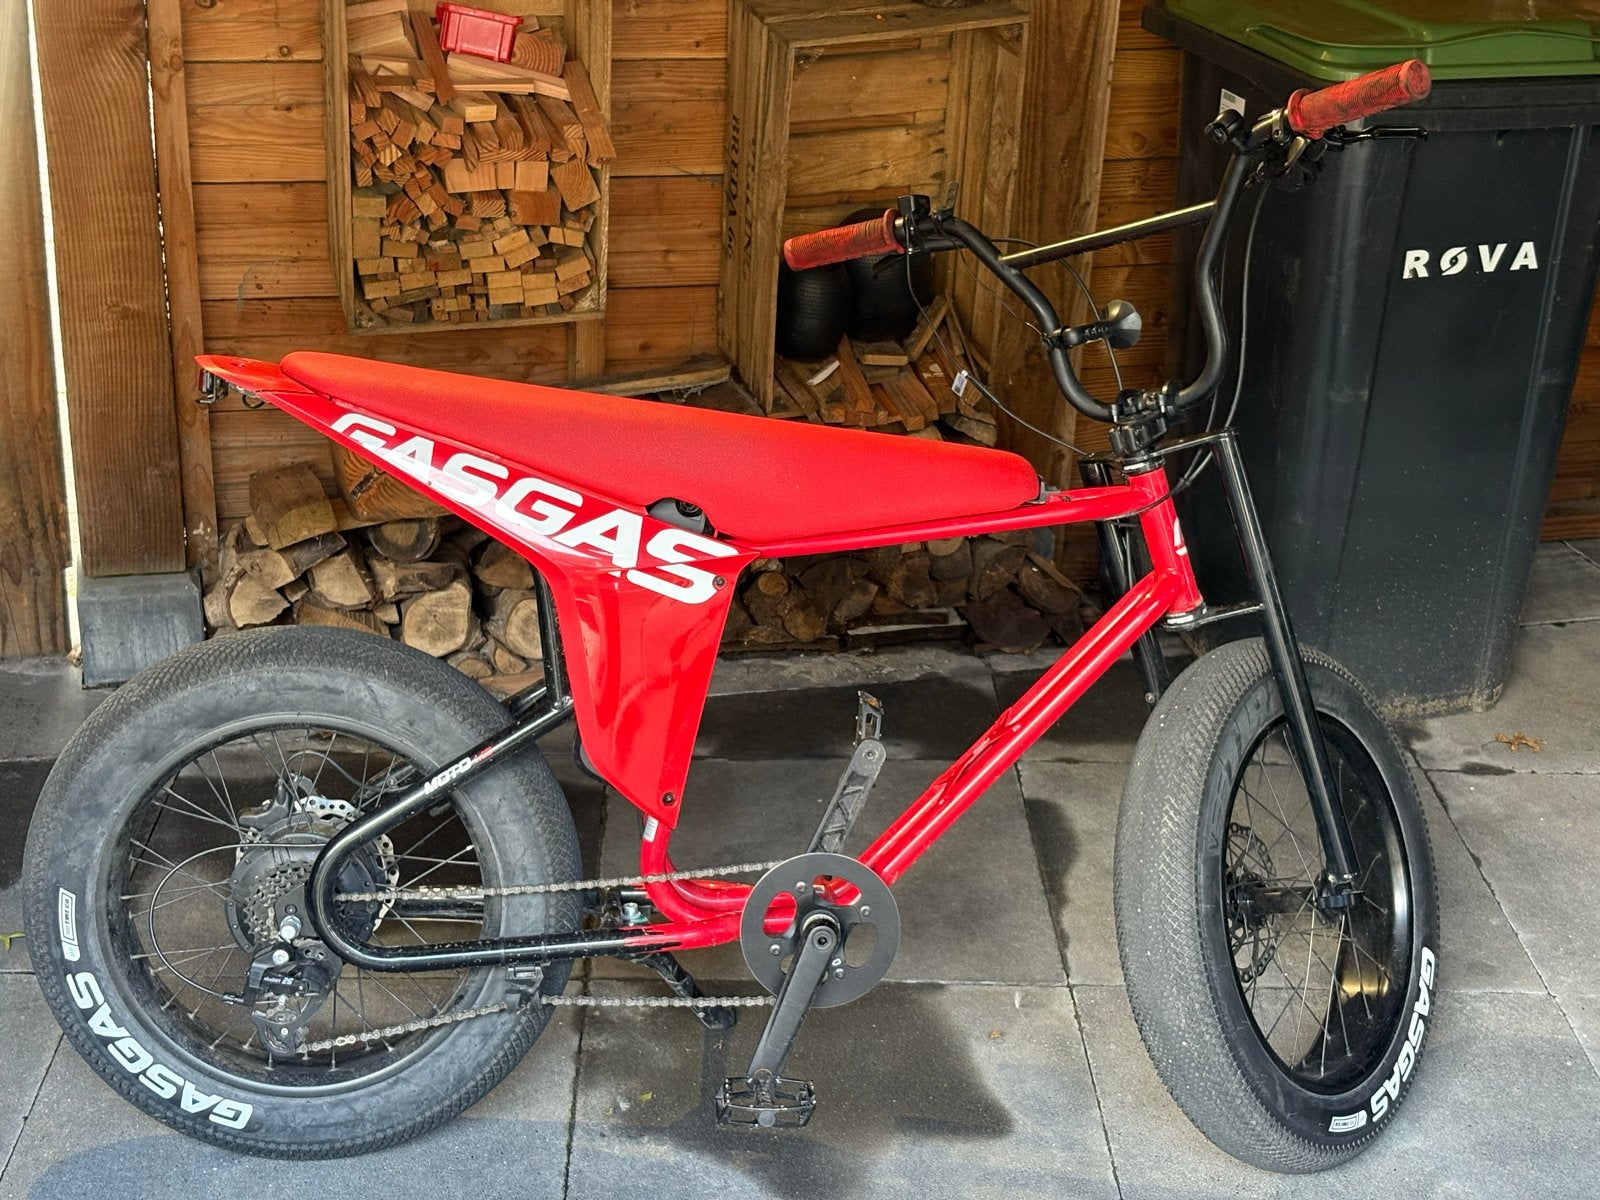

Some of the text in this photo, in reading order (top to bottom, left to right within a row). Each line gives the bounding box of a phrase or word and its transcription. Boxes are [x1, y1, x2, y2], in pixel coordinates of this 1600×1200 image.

[331, 413, 739, 604] GASGAS
[424, 757, 472, 795] MOTO
[66, 972, 253, 1130] GASGAS
[1370, 946, 1435, 1122] GASGAS
